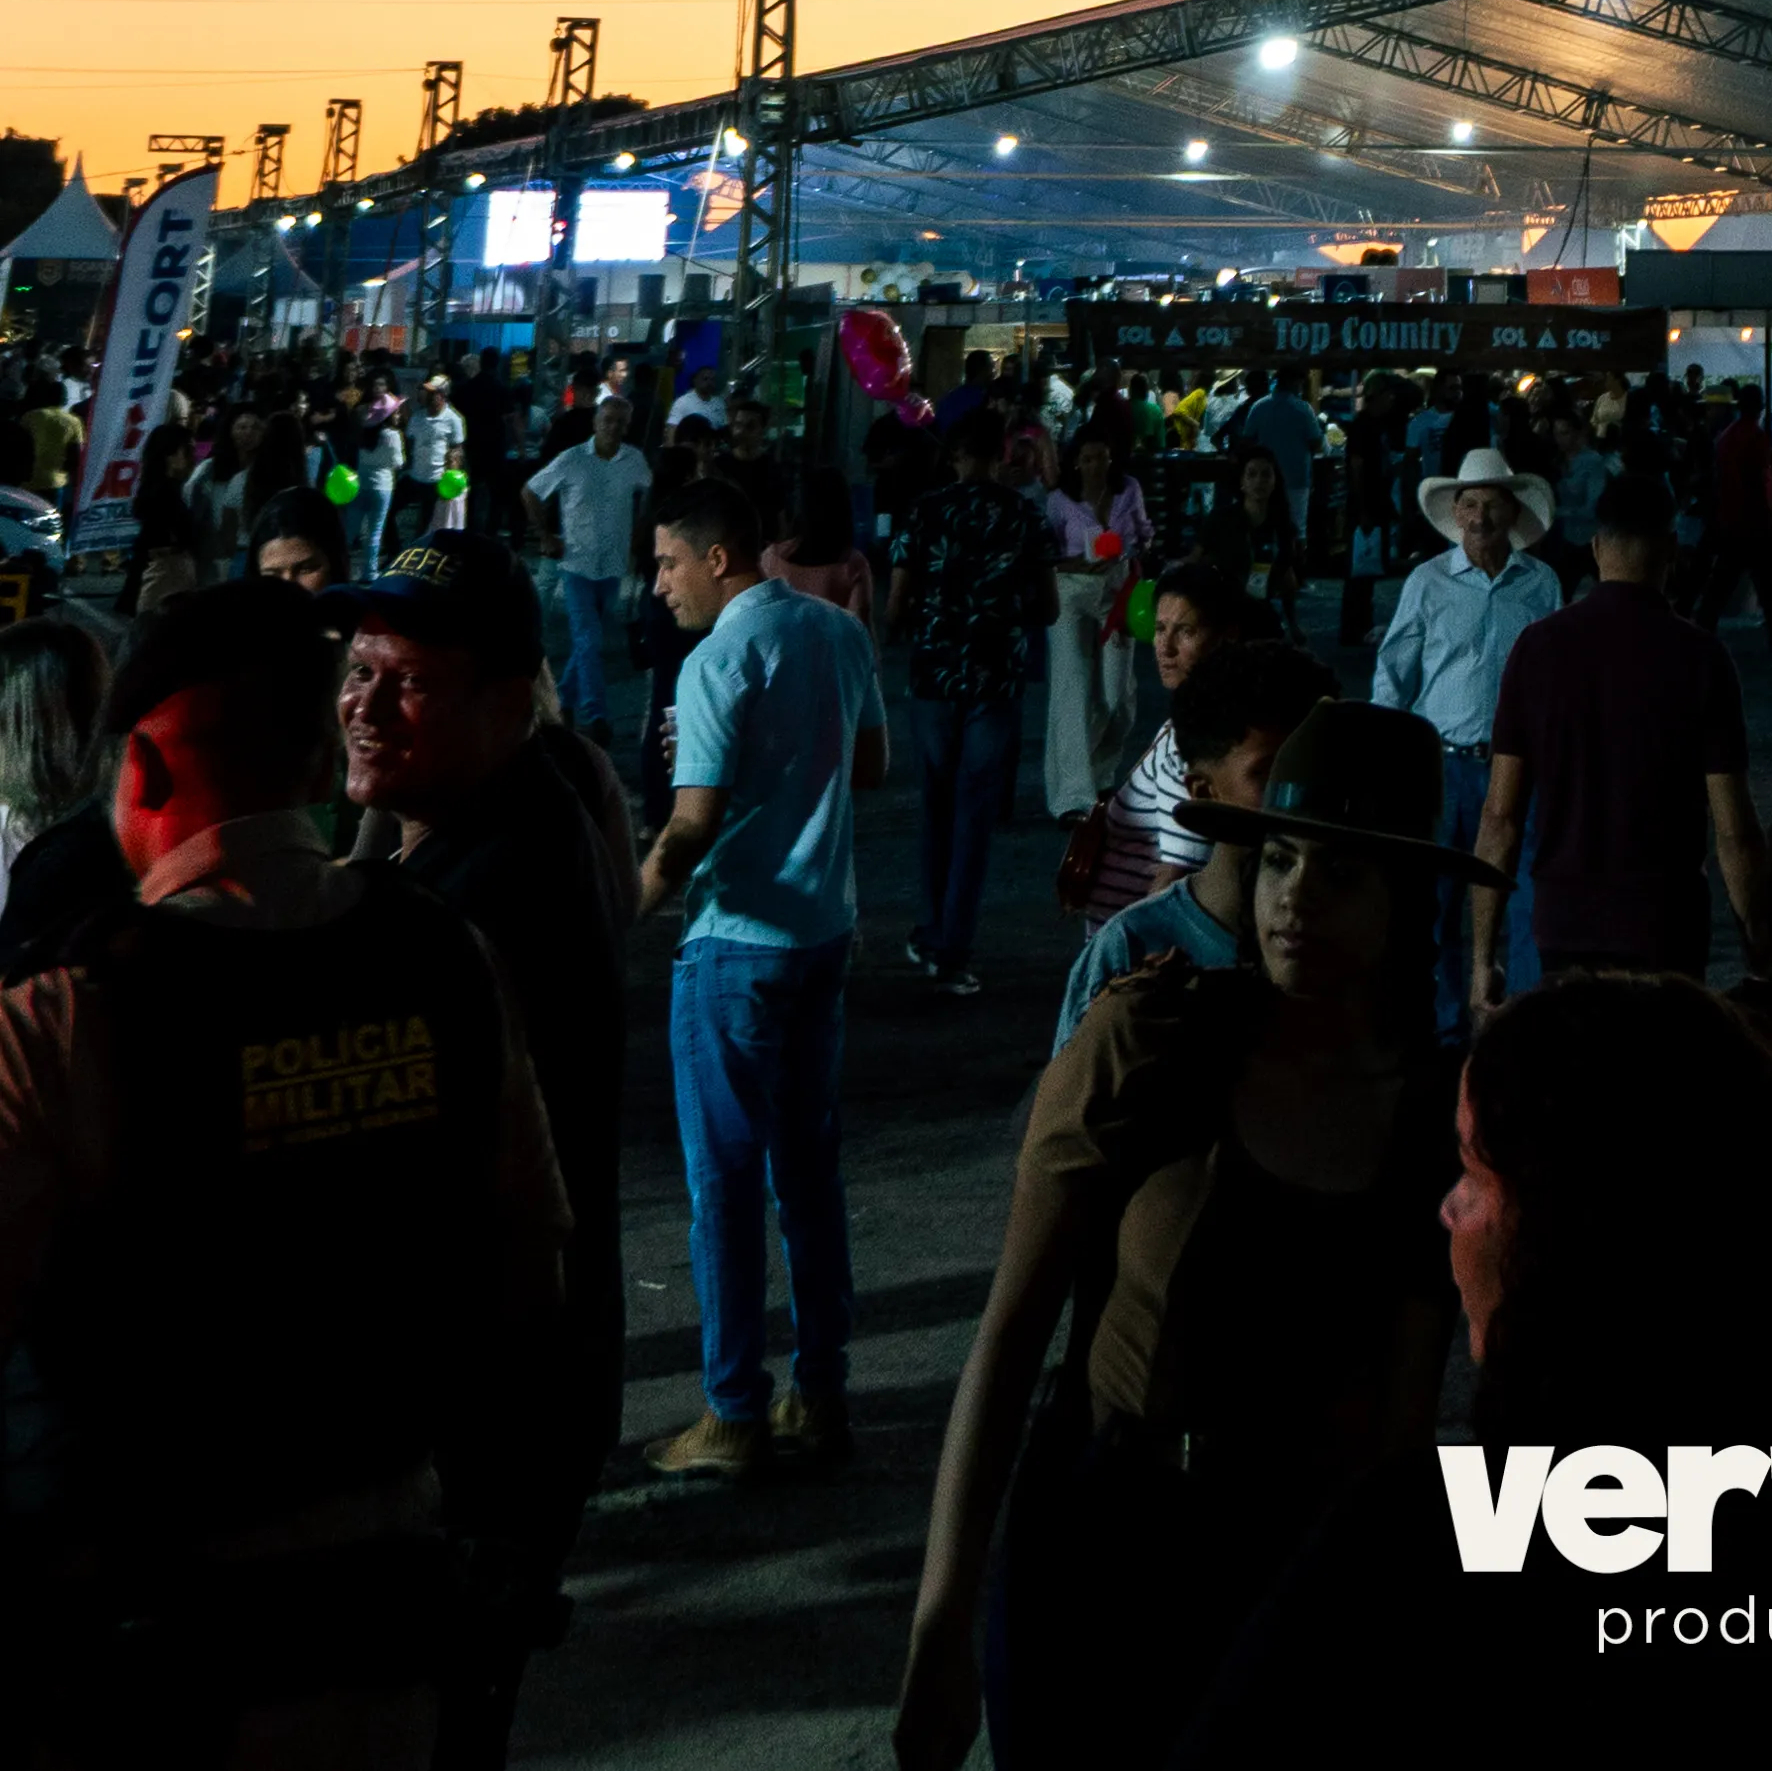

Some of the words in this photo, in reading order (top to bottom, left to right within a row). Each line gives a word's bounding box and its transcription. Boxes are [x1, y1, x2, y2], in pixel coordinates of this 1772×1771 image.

[1273, 315, 1331, 356] Top
[1341, 315, 1465, 356] Country
[242, 1061, 438, 1133] MILITAR
